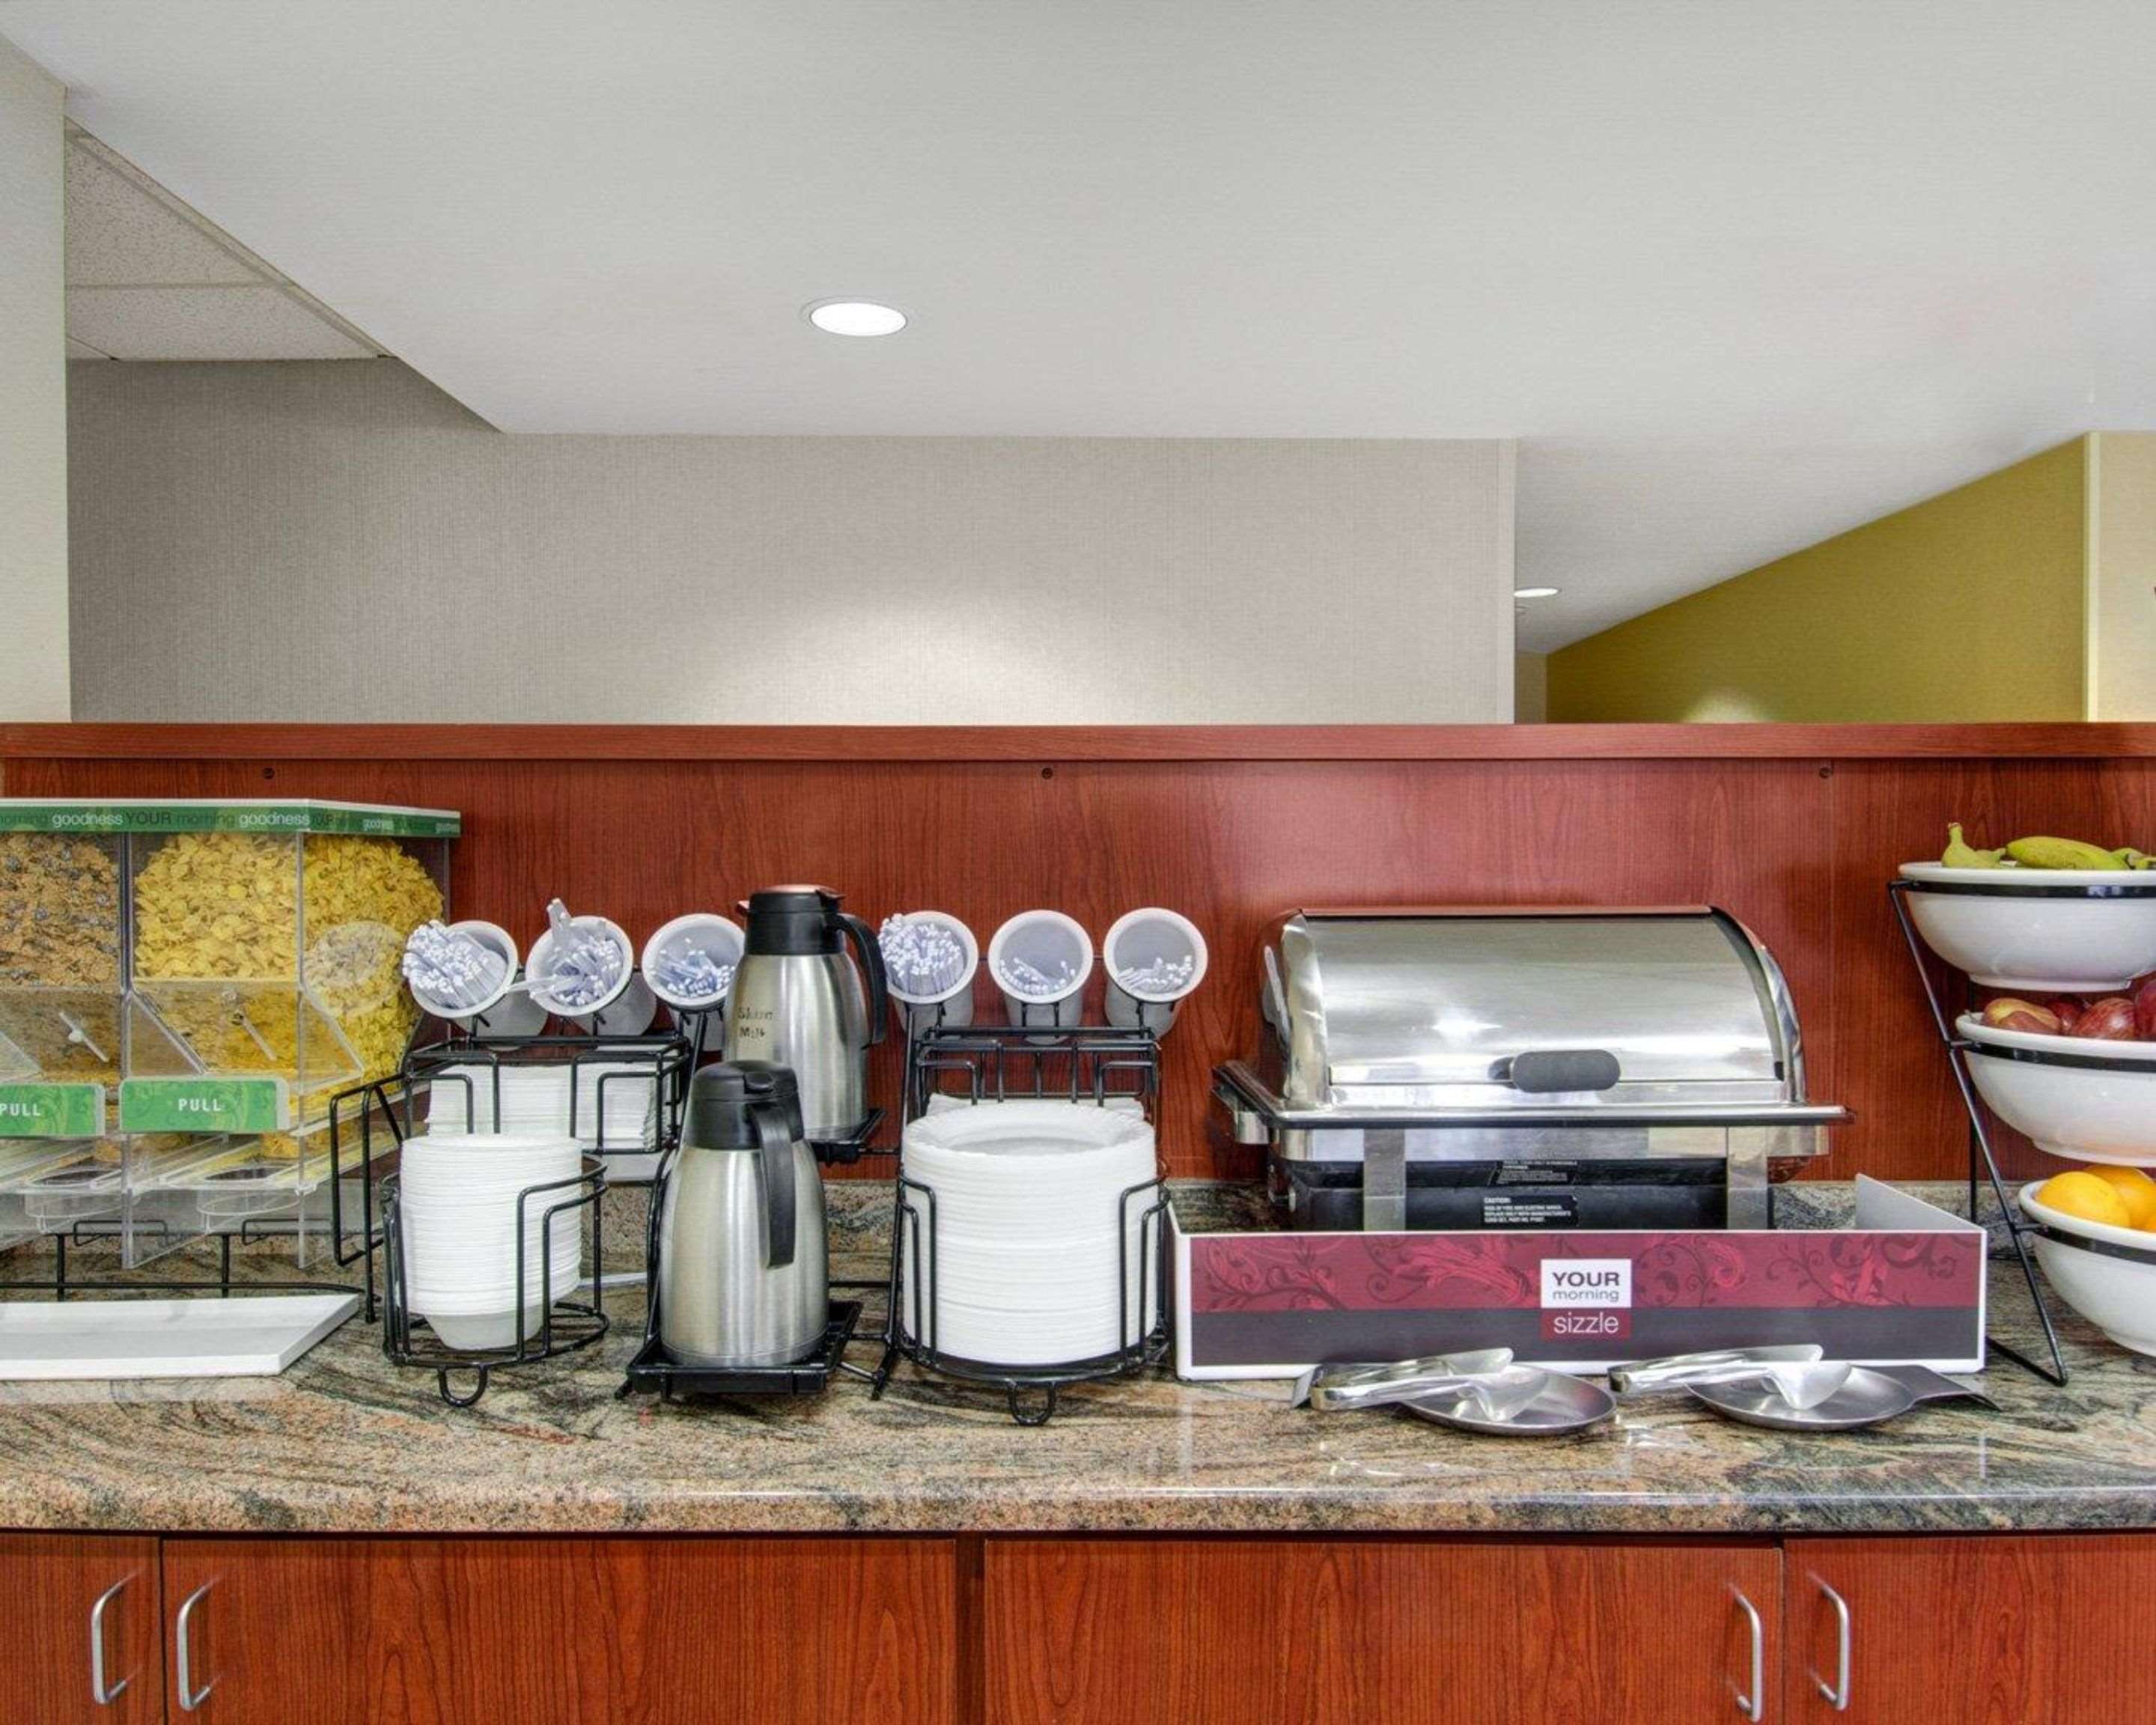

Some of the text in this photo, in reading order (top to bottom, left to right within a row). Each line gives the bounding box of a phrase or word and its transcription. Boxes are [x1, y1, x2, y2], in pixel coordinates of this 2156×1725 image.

[52, 813, 124, 828] goodness
[125, 812, 172, 824] YOUR
[239, 812, 311, 828] goodness
[0, 1103, 41, 1117] PULL
[177, 1098, 223, 1113] PULL
[1552, 1271, 1620, 1286] YOUR
[1552, 1286, 1619, 1303] morning
[1553, 1311, 1619, 1334] sizzle
